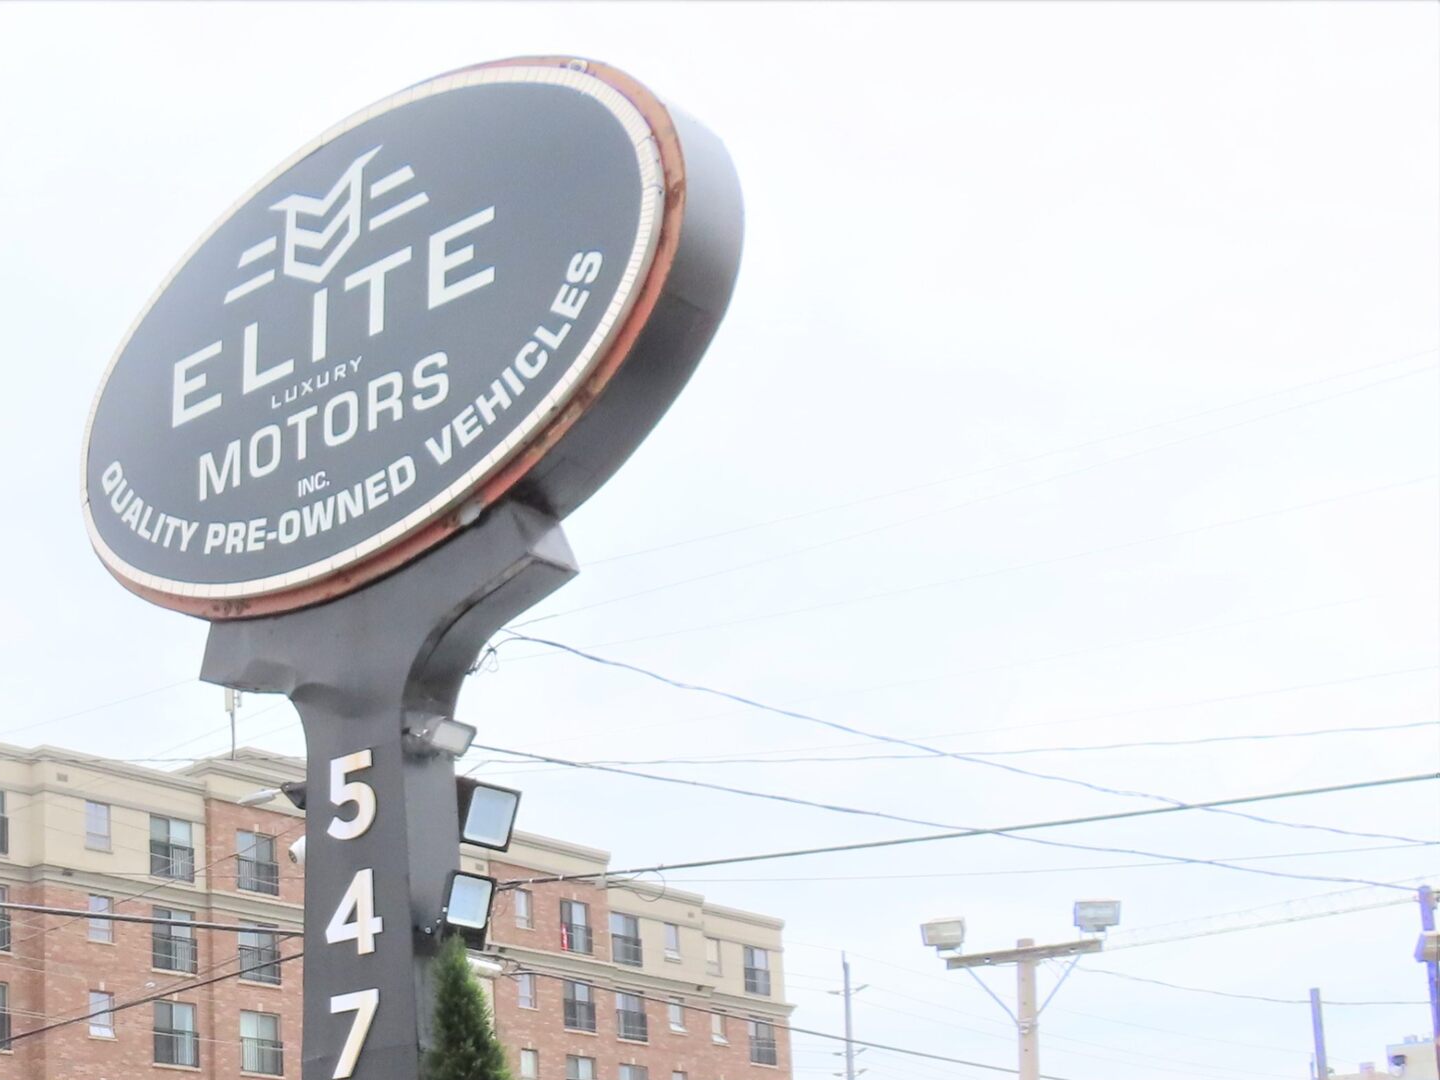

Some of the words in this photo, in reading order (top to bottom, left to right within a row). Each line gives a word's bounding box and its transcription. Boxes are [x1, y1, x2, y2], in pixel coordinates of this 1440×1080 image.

[171, 205, 496, 429] ELITE
[270, 355, 363, 409] LUXURY
[101, 460, 200, 555] QUALITY
[203, 462, 417, 556] PRE-OWNED
[424, 249, 604, 467] VEHICLES
[197, 351, 450, 501] MOTORS
[296, 471, 331, 498] INC.
